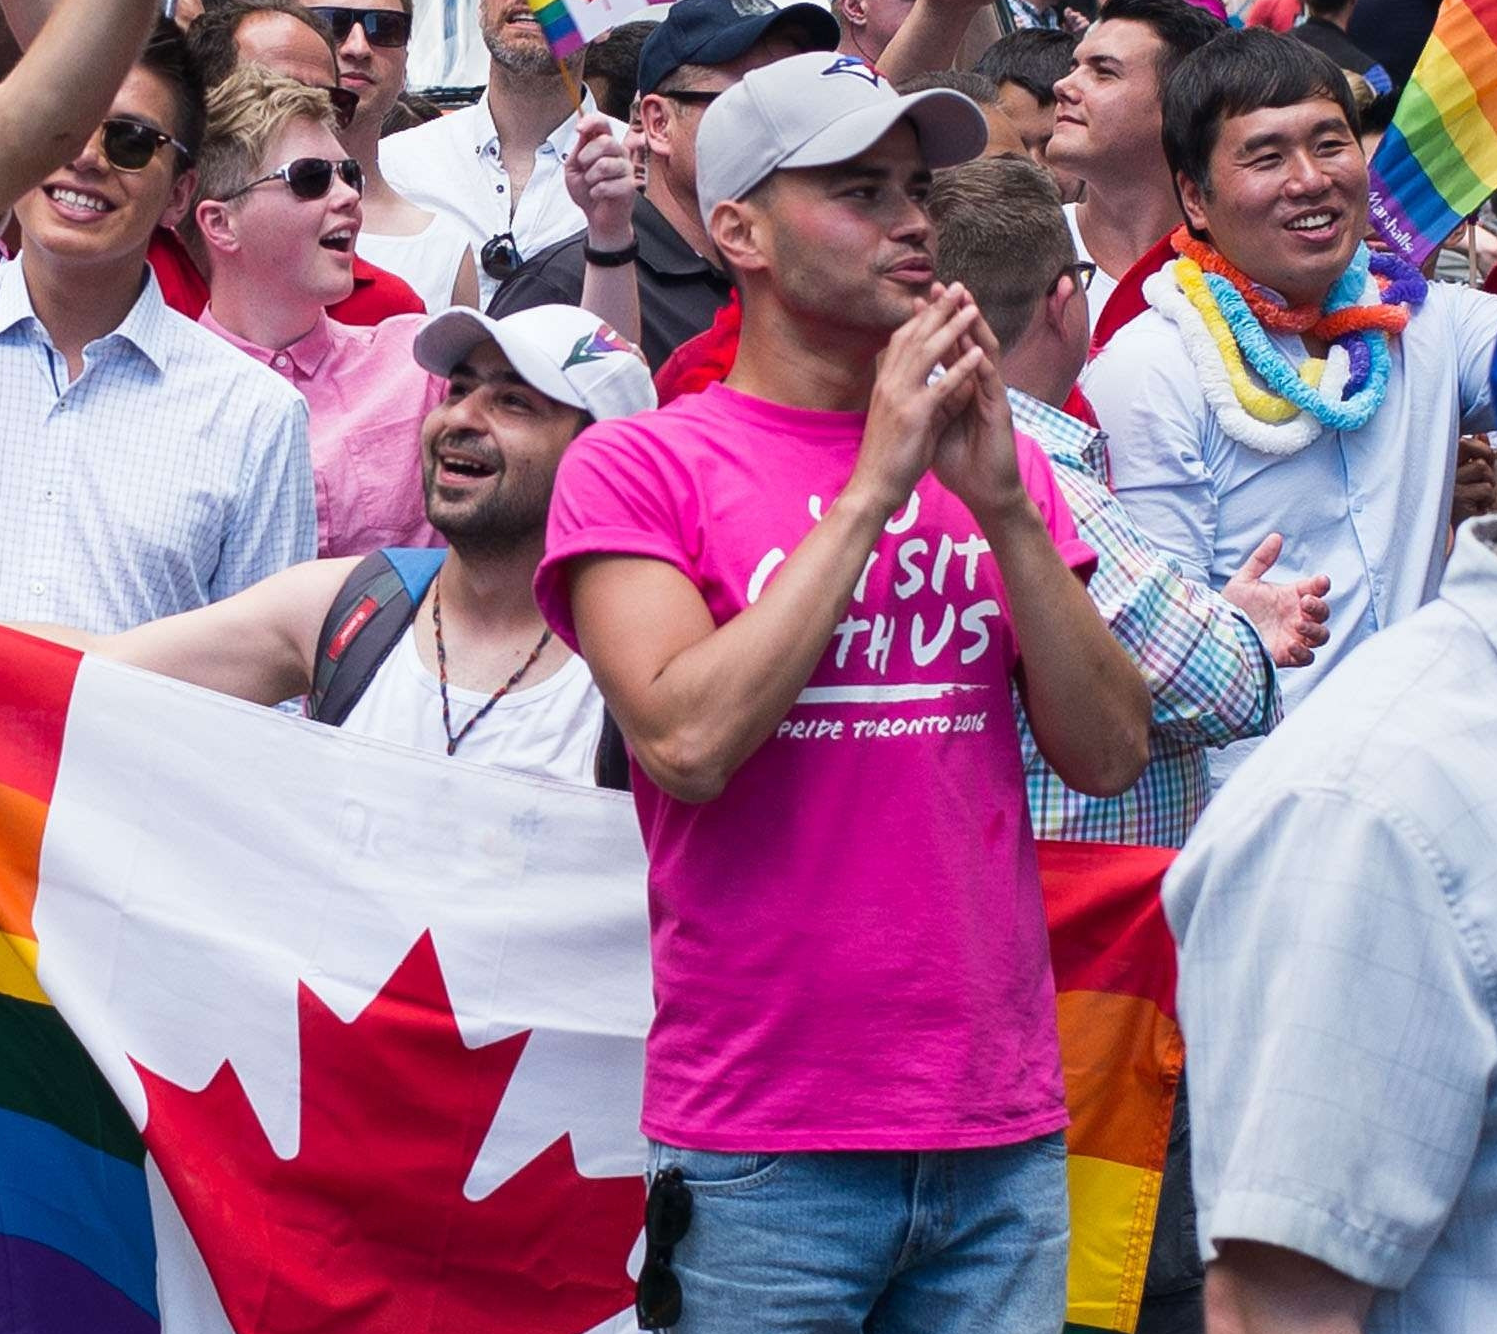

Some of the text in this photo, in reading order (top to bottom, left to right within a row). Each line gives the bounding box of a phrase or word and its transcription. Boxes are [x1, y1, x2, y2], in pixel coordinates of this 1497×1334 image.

[1367, 190, 1415, 255] Marshalls
[894, 532, 992, 601] SIT
[833, 599, 1001, 677] TH US
[775, 711, 988, 740] PRIDE TORONTO 2016
